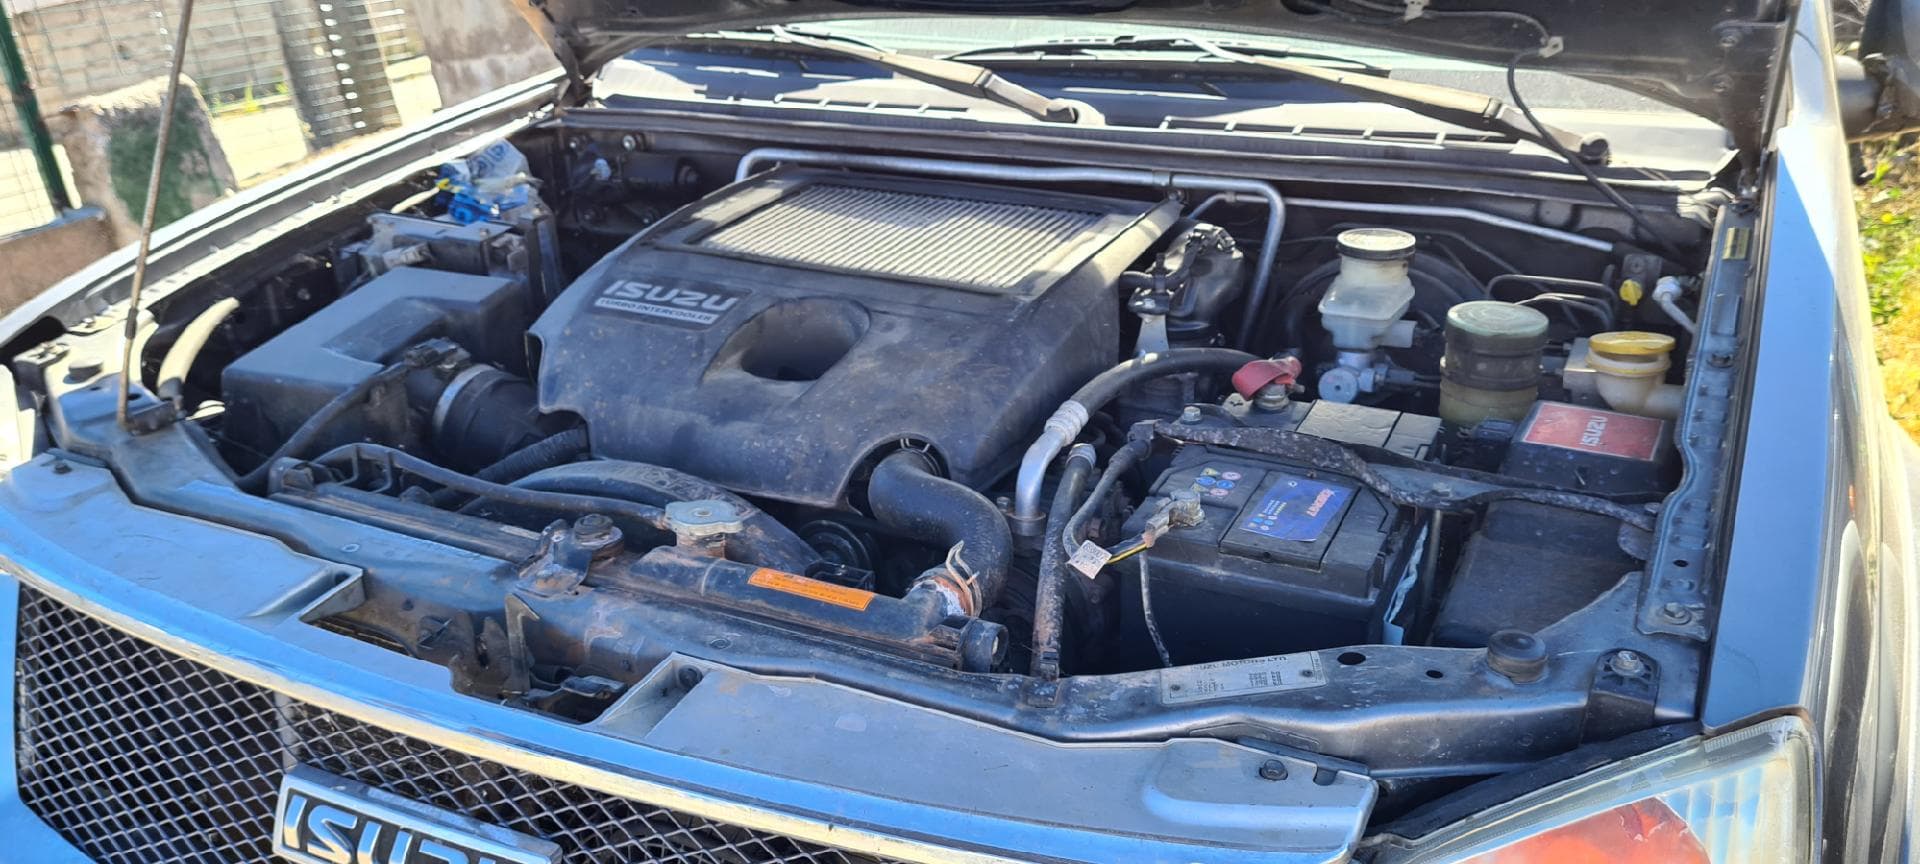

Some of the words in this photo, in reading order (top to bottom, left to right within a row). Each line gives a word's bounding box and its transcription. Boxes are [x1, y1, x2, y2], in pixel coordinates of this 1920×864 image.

[599, 299, 636, 310] TURBO
[636, 303, 713, 321] INTERCOOLER
[603, 279, 739, 311] ISUZU
[1581, 415, 1609, 447] ISUZU
[283, 794, 496, 864] ISU
